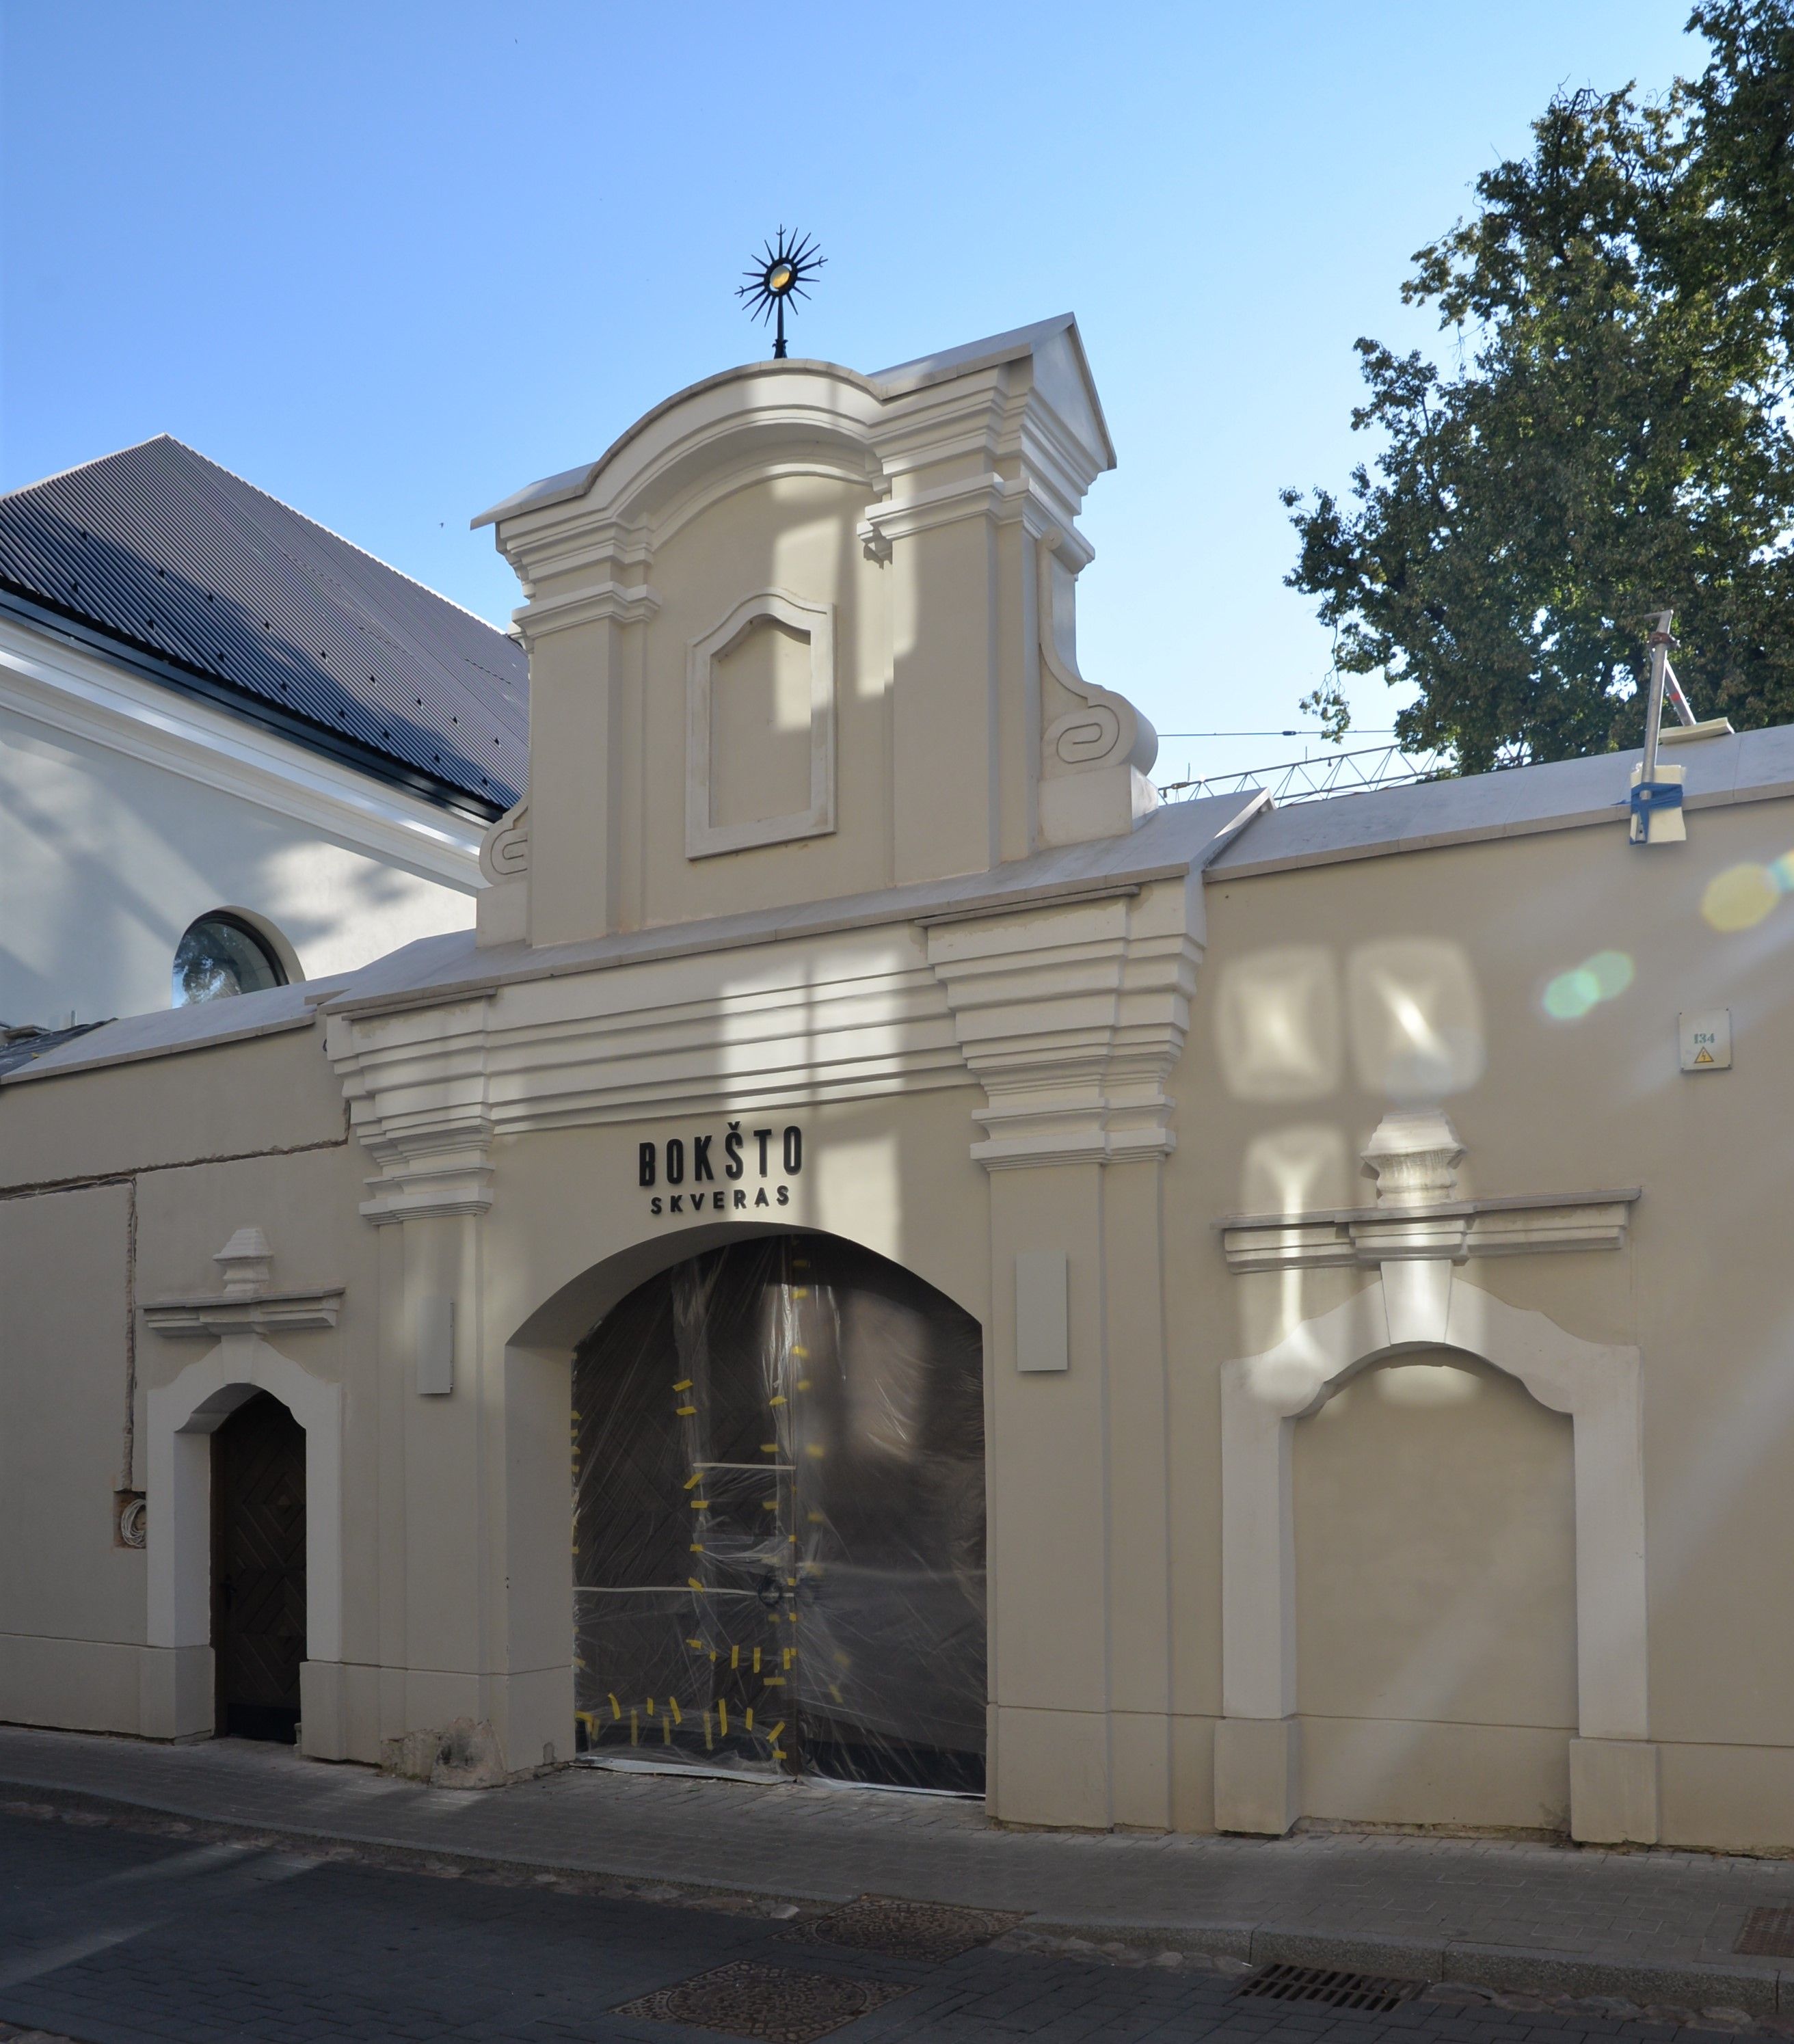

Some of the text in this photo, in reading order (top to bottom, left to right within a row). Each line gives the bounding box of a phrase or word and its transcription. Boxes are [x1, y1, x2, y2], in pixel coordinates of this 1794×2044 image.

[1693, 1033, 1715, 1044] 134
[639, 1121, 802, 1186] BOKŠTO
[651, 1185, 790, 1215] SKVERAS
